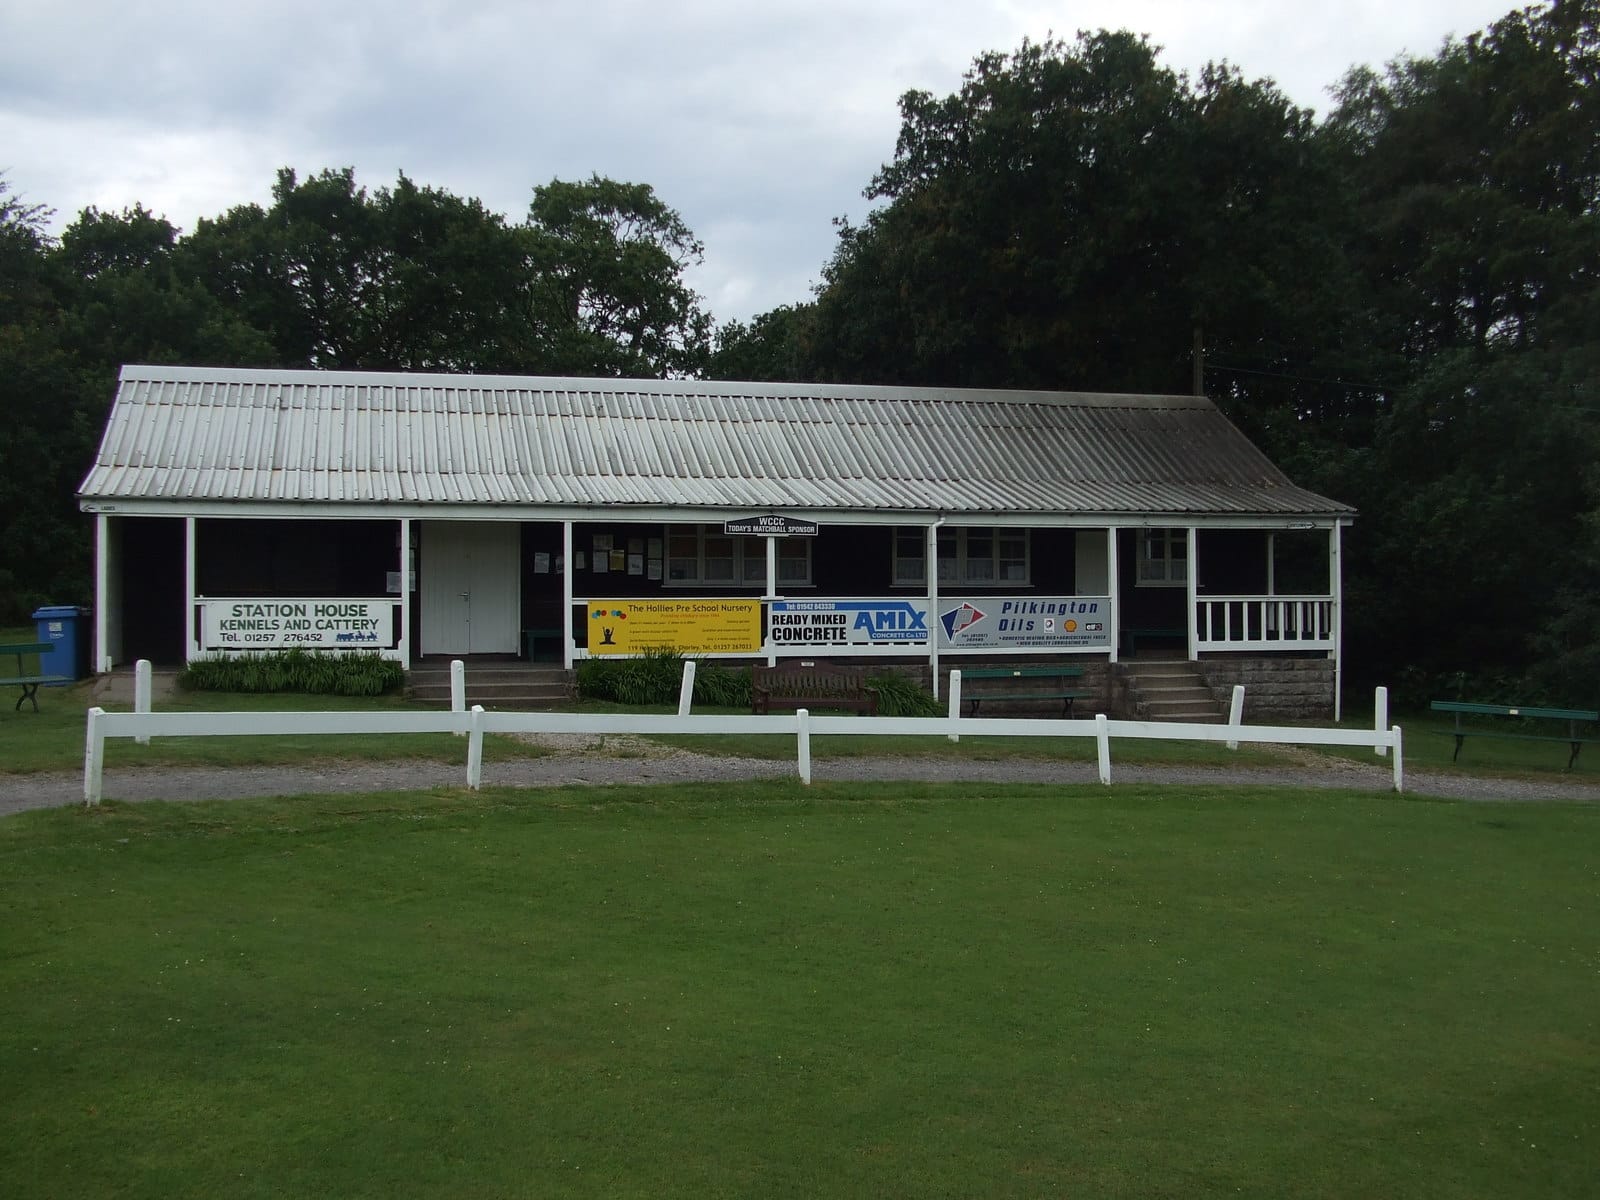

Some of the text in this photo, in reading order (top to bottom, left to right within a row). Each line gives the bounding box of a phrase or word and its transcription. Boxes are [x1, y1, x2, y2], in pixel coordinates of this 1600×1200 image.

[759, 517, 785, 526] WCCC
[752, 525, 787, 533] MATCHBALL
[231, 604, 369, 618] STATION HOUSE
[627, 603, 753, 614] The Hollies Pre School Nursery
[1001, 601, 1099, 616] Pilkington
[219, 618, 379, 631] KENNELS AND CATTERY
[771, 614, 847, 625] READY MIXED
[853, 610, 928, 630] AMIX
[998, 618, 1036, 631] Oils
[219, 632, 323, 642] Tel. 01257 276452
[771, 626, 847, 641] CONCRETE
